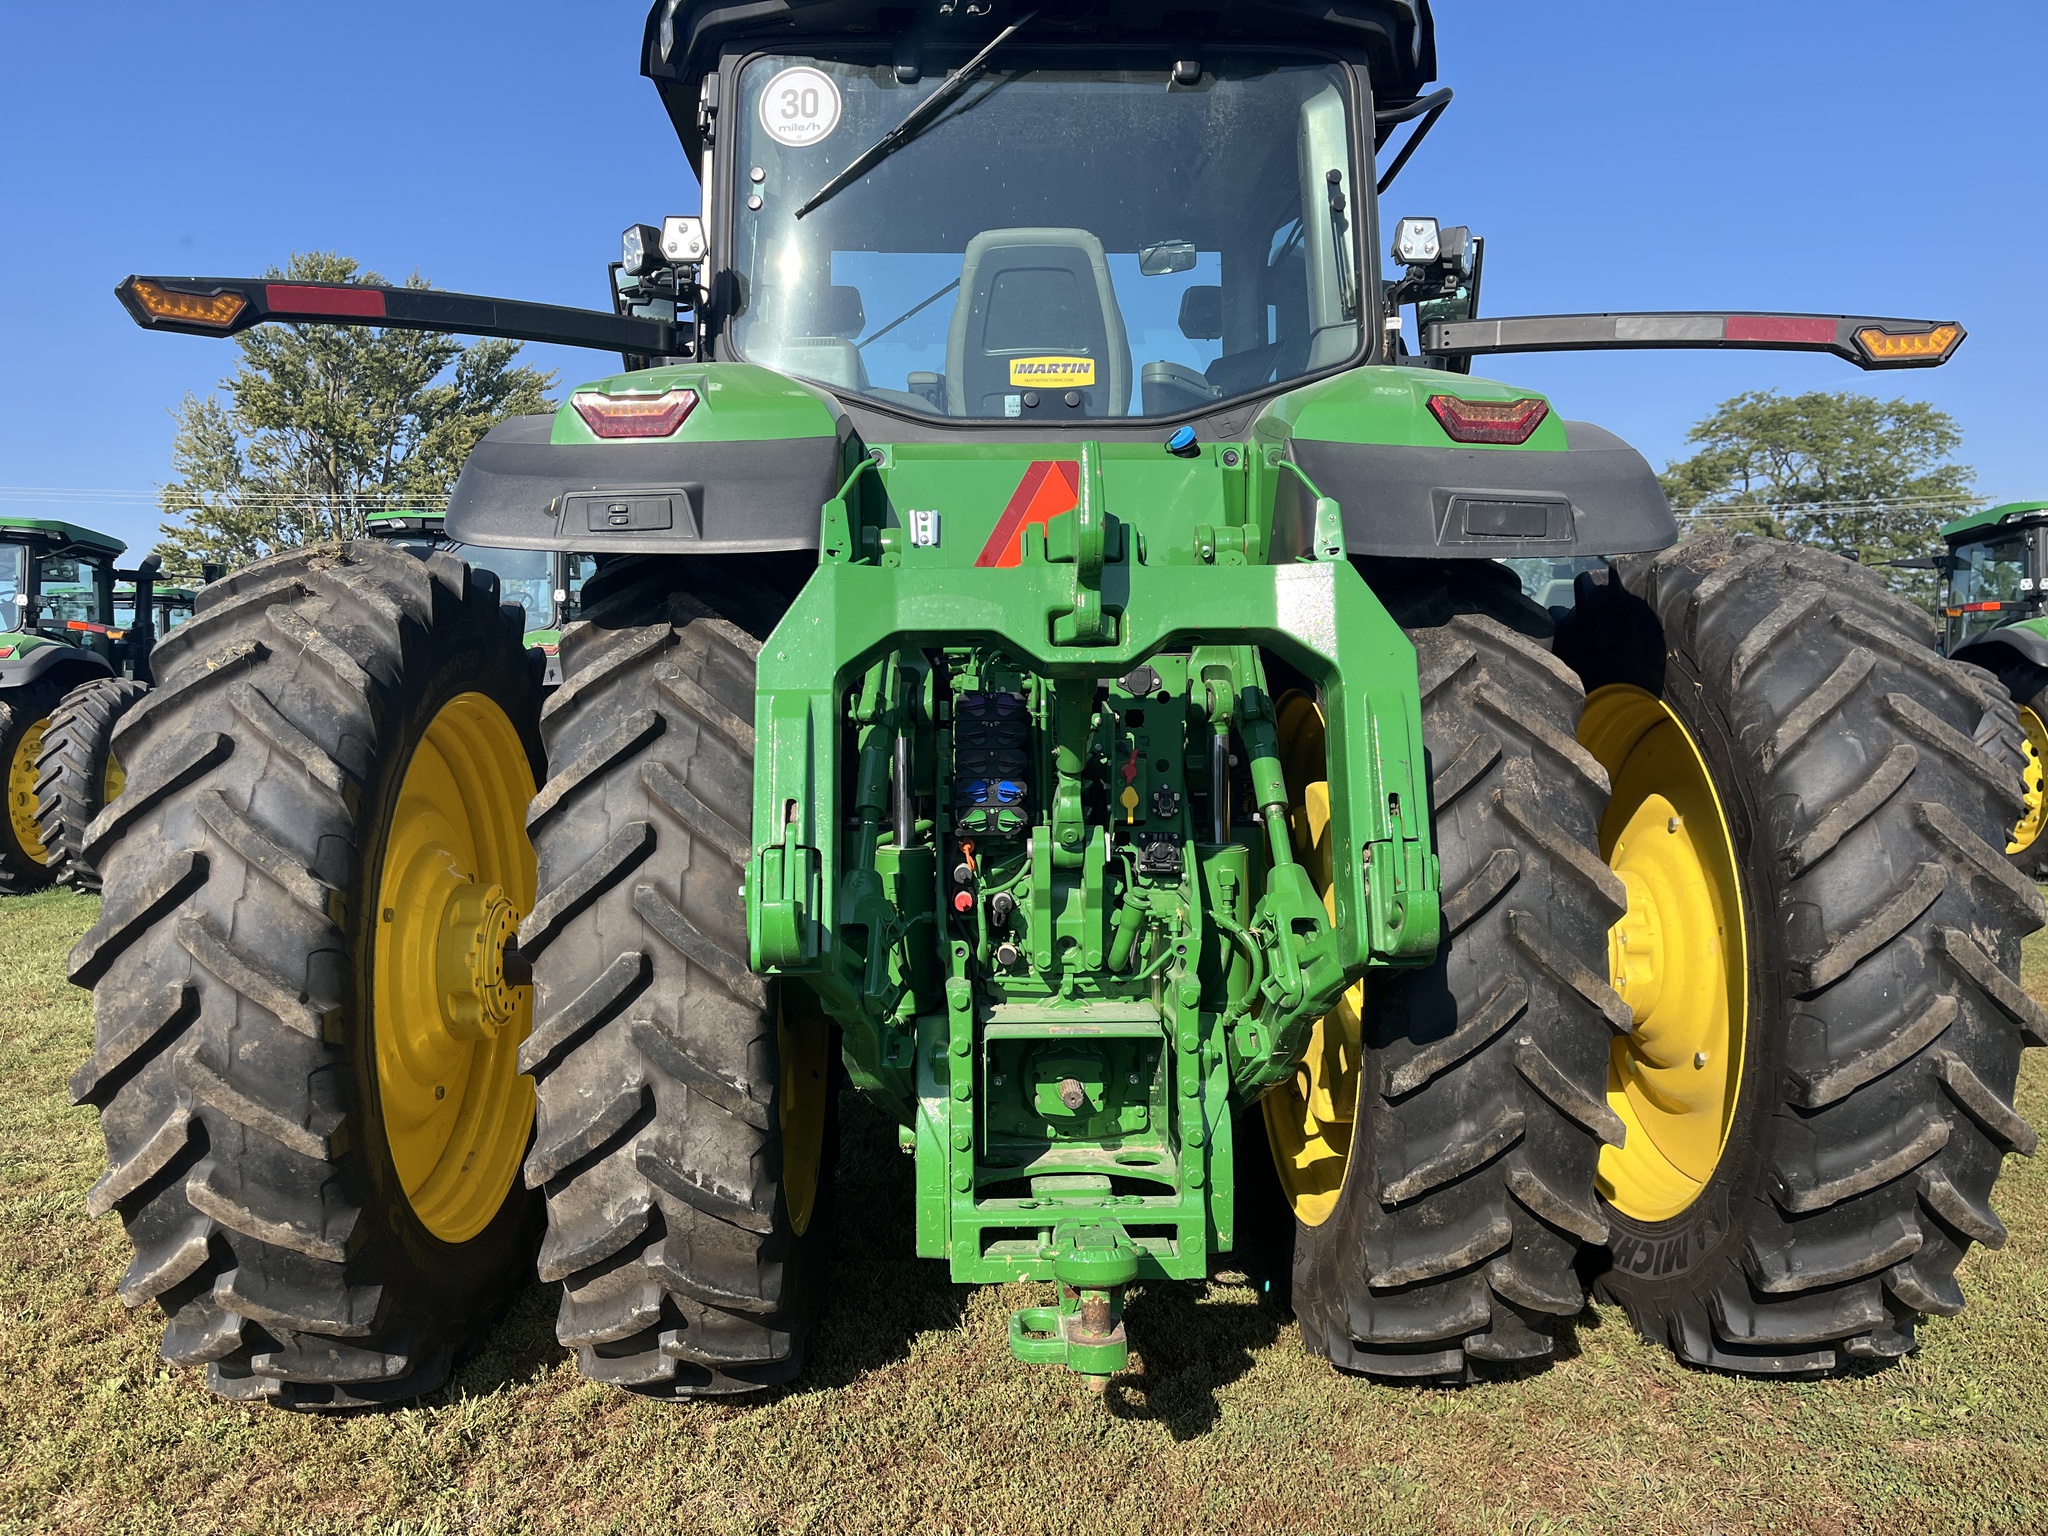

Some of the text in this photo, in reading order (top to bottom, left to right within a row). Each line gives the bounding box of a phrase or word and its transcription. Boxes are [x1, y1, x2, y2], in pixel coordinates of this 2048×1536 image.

[781, 88, 819, 119] 30
[778, 122, 821, 132] mile/h
[1016, 363, 1091, 374] MARTIN
